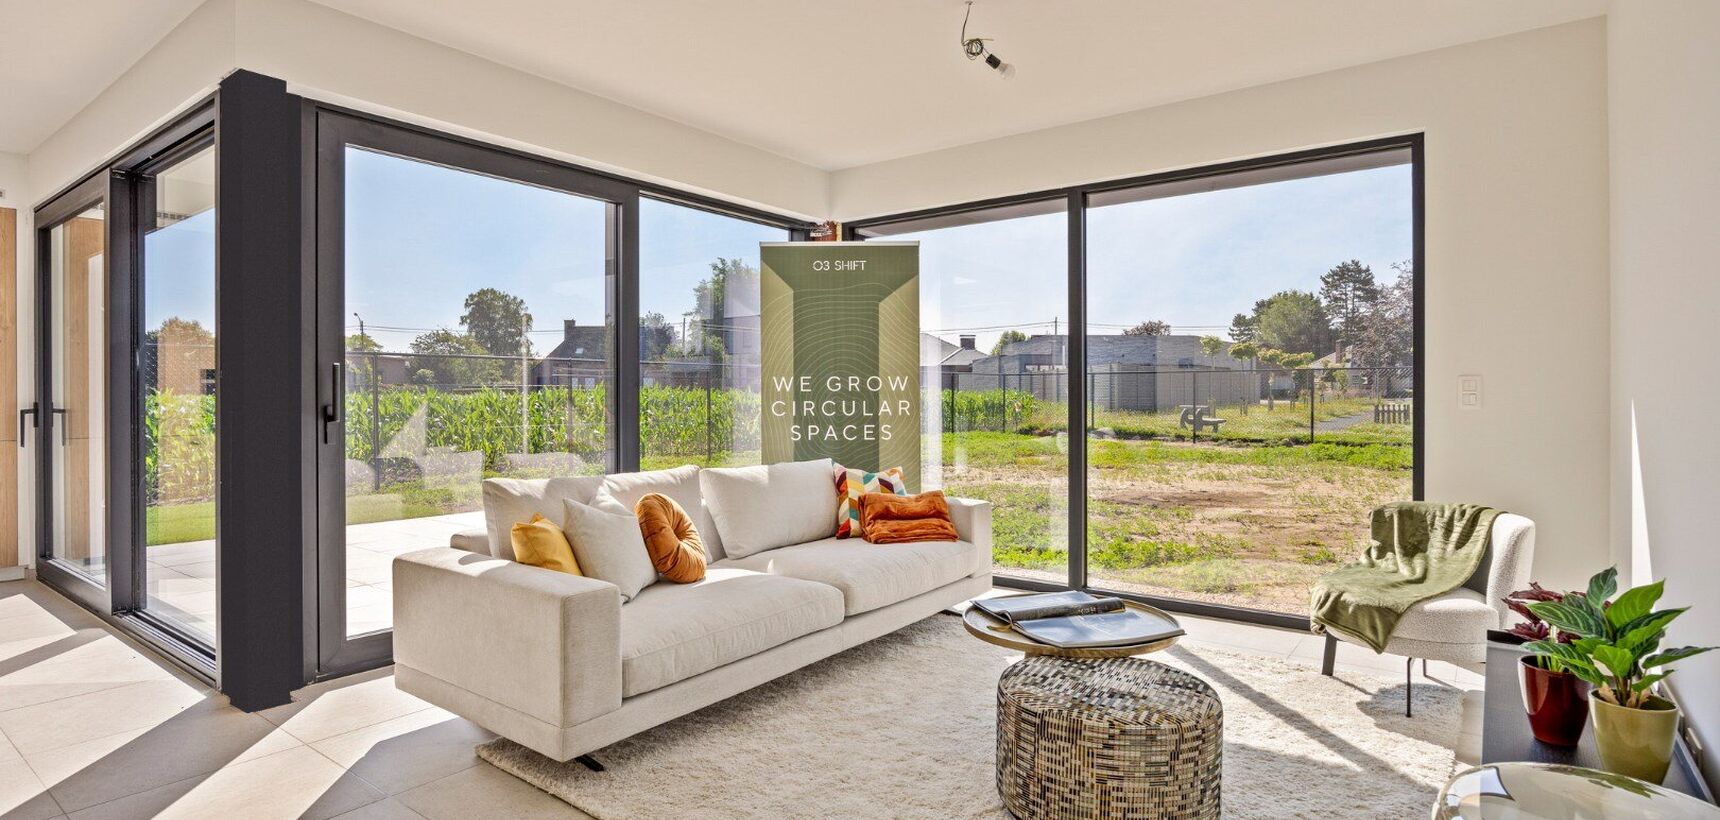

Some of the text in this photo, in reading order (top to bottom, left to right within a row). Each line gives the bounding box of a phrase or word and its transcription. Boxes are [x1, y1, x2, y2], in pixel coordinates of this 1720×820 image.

[834, 260, 866, 271] SHIFT
[773, 376, 909, 392] WE GROW
[771, 400, 911, 417] CIRCULAR
[790, 424, 892, 441] SPACES
